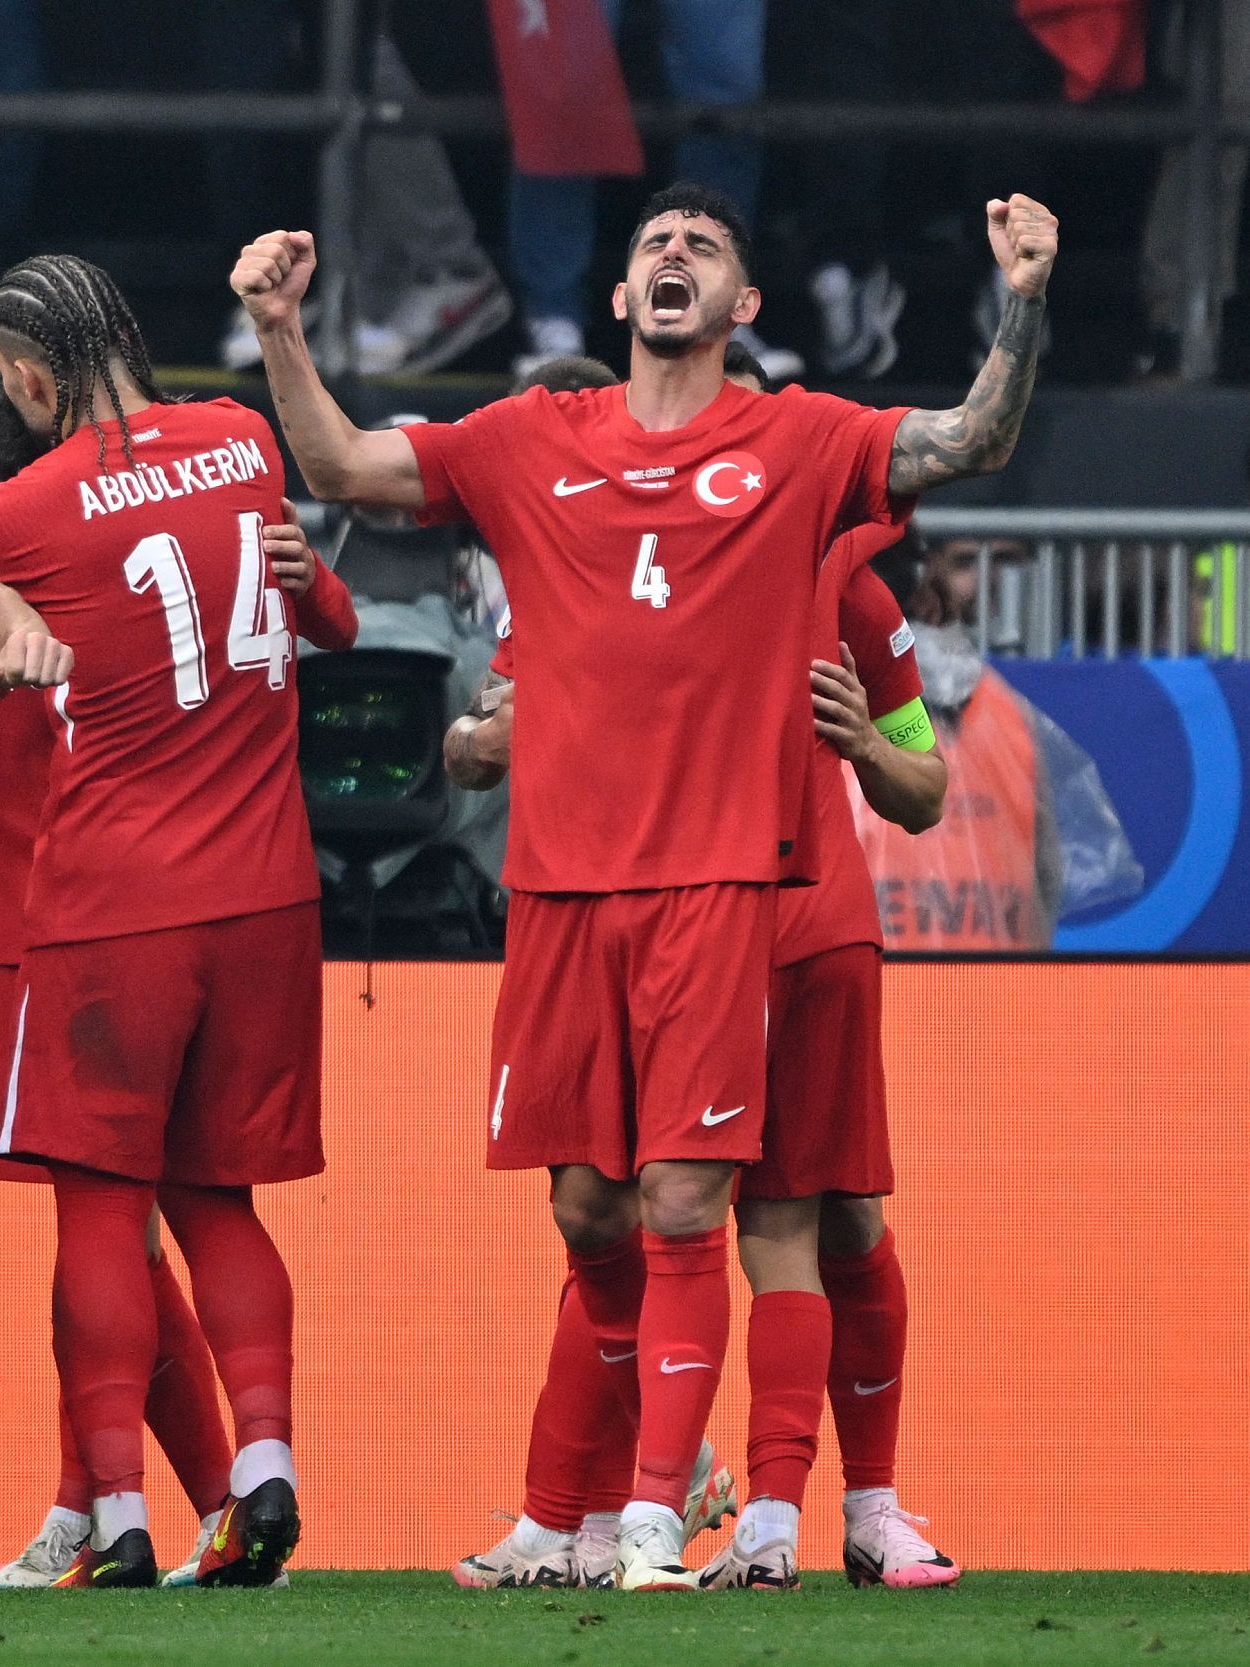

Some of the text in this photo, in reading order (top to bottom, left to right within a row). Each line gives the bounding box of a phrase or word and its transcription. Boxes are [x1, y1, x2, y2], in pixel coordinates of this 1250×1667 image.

[79, 437, 269, 521] ABDÜLKERİM
[123, 511, 293, 711] 14
[631, 533, 671, 609] 4
[888, 713, 928, 745] ESPECT
